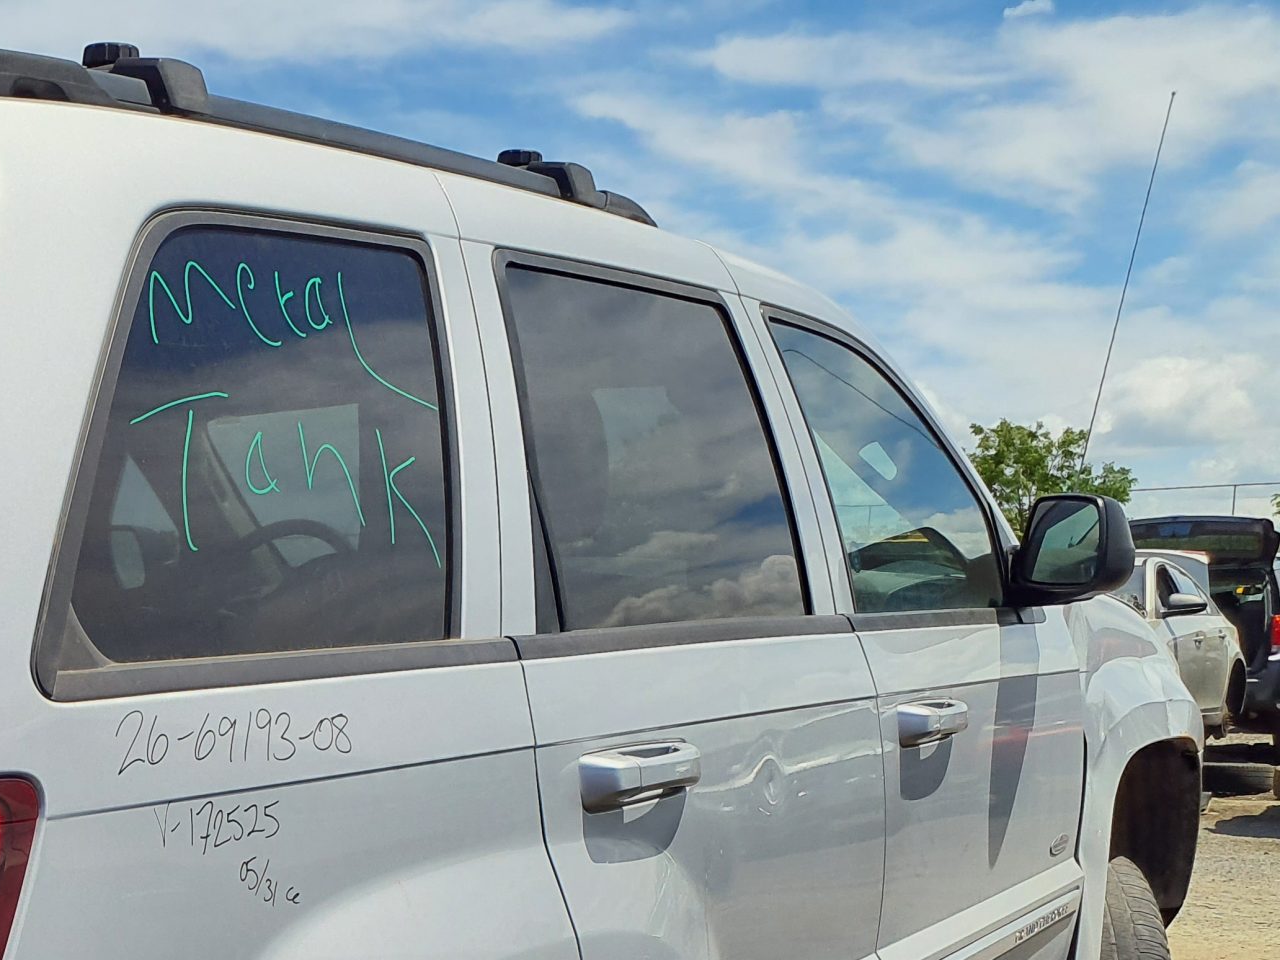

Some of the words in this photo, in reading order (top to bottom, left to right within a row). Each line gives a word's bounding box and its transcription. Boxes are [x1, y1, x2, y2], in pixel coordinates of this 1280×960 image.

[148, 260, 439, 411] Metal
[129, 391, 442, 570] Tank
[115, 707, 352, 776] 26-69193-08
[153, 799, 280, 856] V-172525
